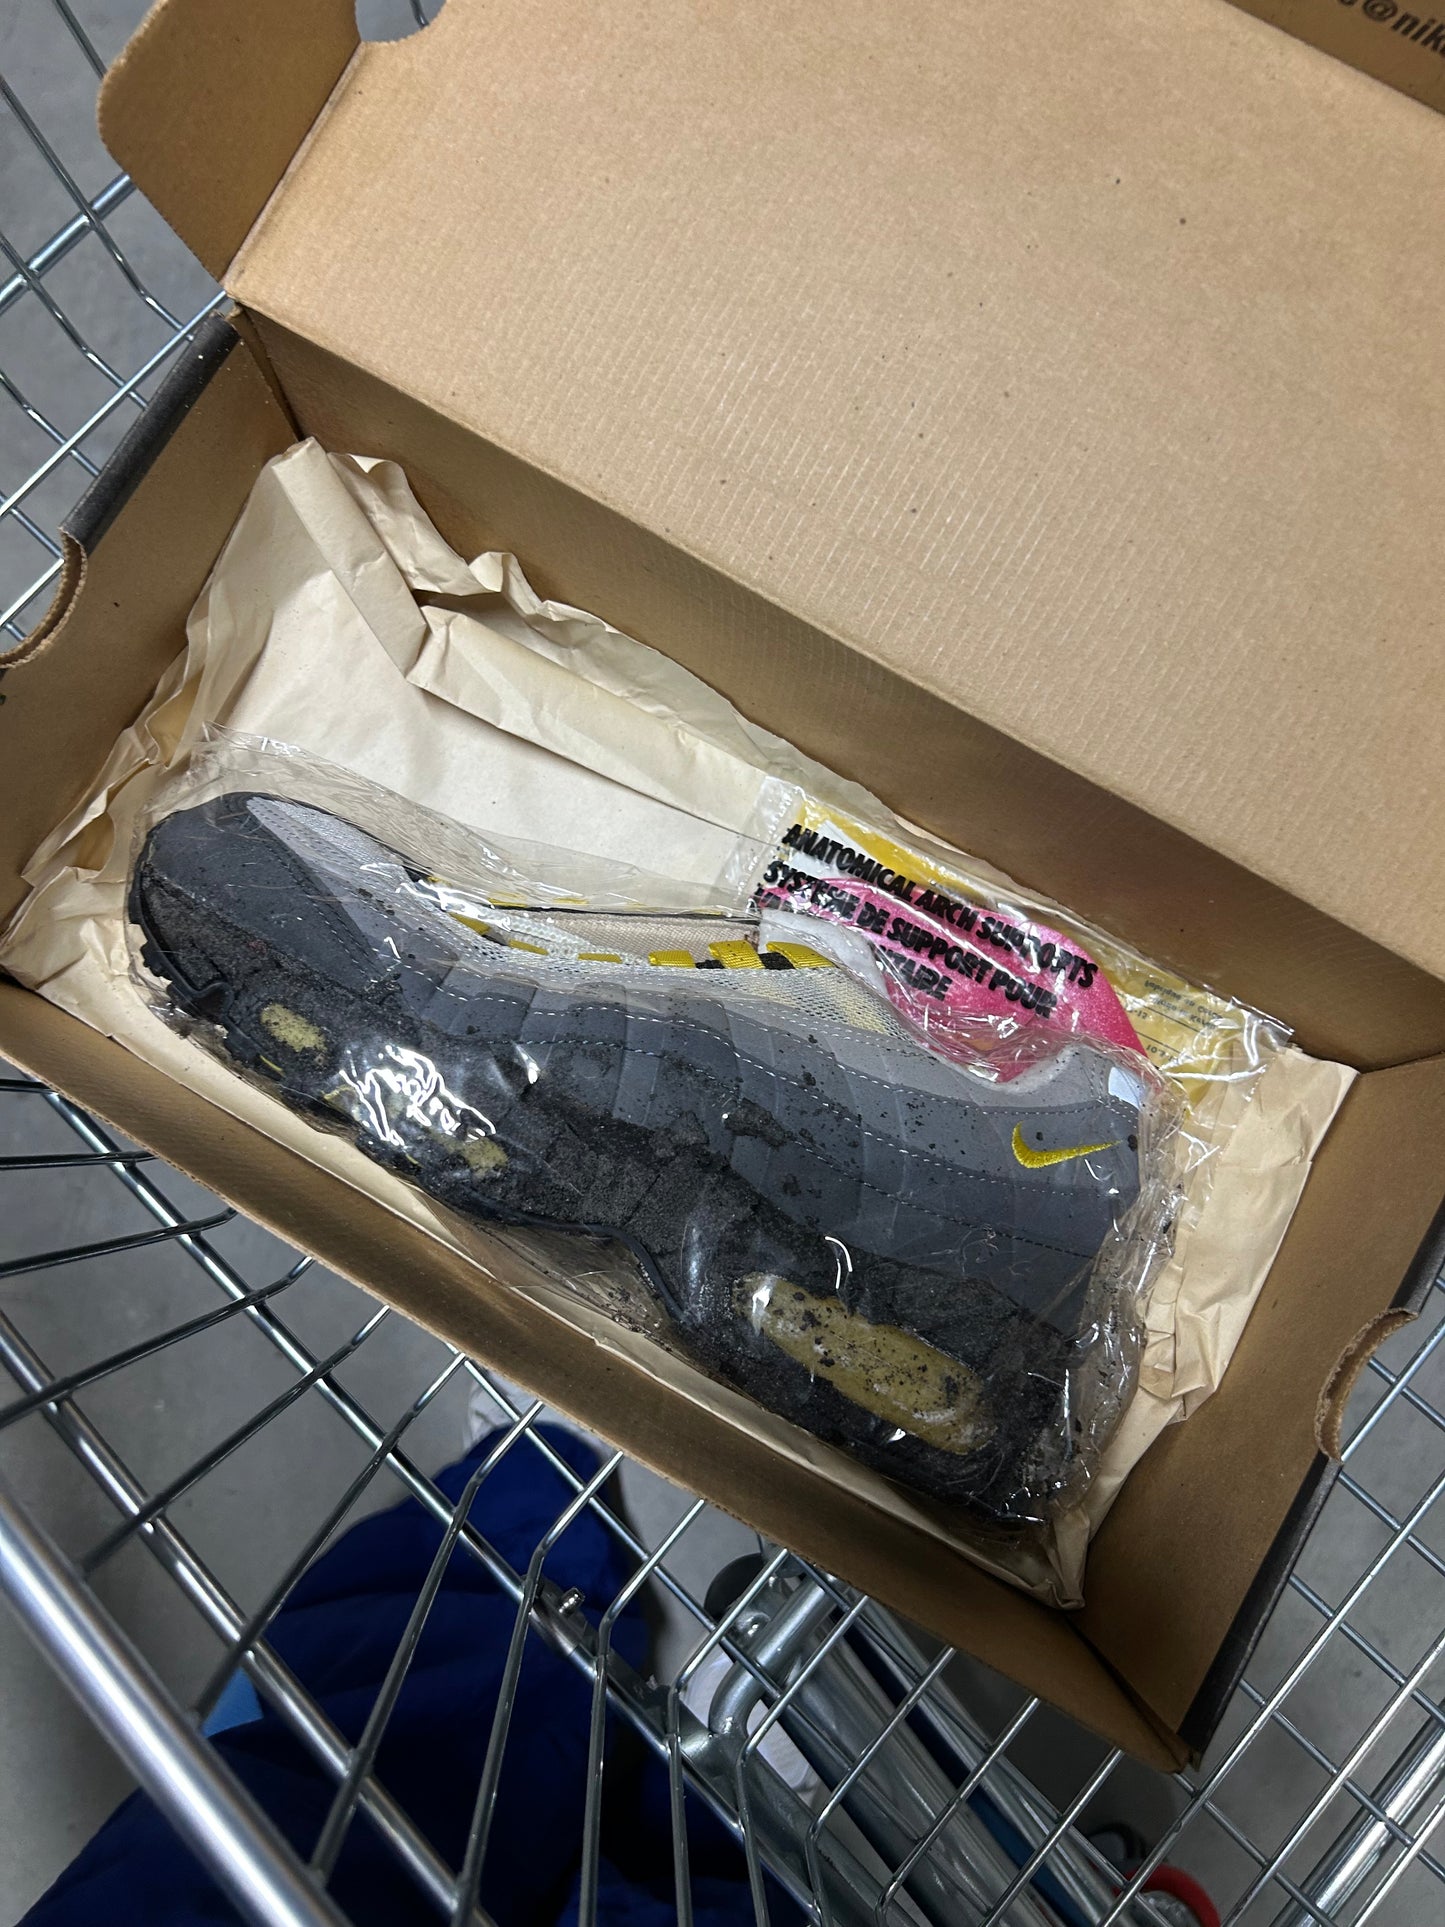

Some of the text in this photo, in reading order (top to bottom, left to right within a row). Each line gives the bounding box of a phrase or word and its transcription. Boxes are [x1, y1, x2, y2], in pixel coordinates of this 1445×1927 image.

[1337, 0, 1445, 58] @nik
[781, 823, 917, 904] ANATOMICAL
[914, 889, 980, 932] ARCH
[976, 916, 1099, 988] SUPPORTS
[856, 901, 891, 935] DE
[887, 917, 995, 985] SUPPORT
[988, 969, 1058, 1019] POUR
